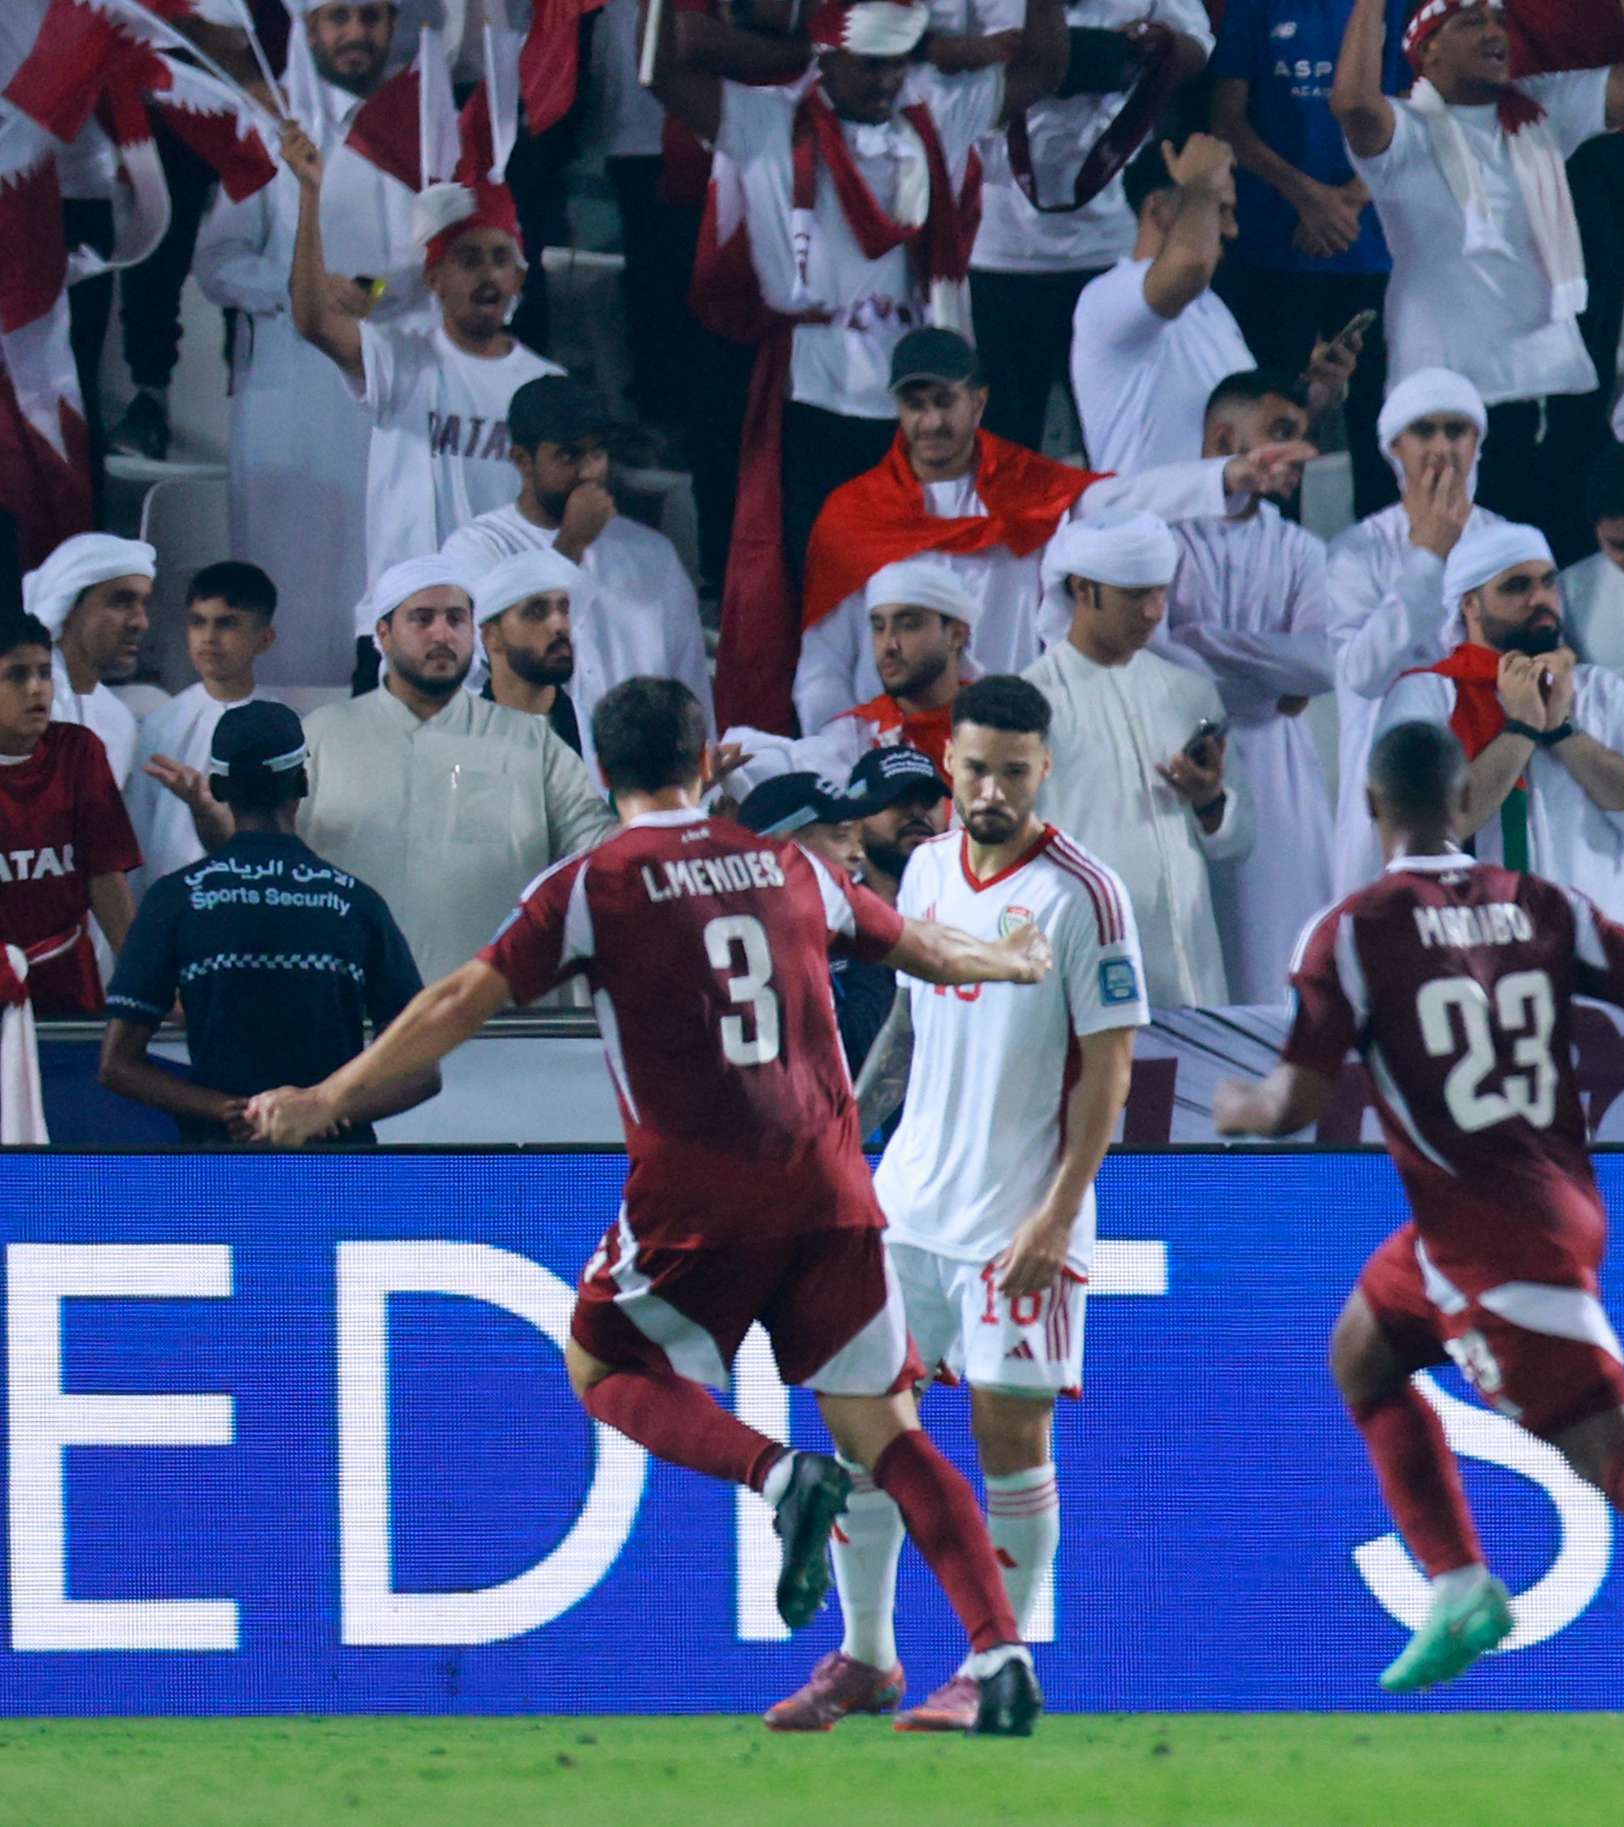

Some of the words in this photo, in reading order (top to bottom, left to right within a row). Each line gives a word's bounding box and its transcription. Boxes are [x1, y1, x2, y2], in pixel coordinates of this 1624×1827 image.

[190, 886, 261, 911] Sports
[264, 887, 352, 917] Security
[640, 849, 786, 904] L.MENDES
[703, 914, 780, 1067] 3
[1416, 969, 1560, 1134] 23
[5, 1239, 1169, 1652] EDI
